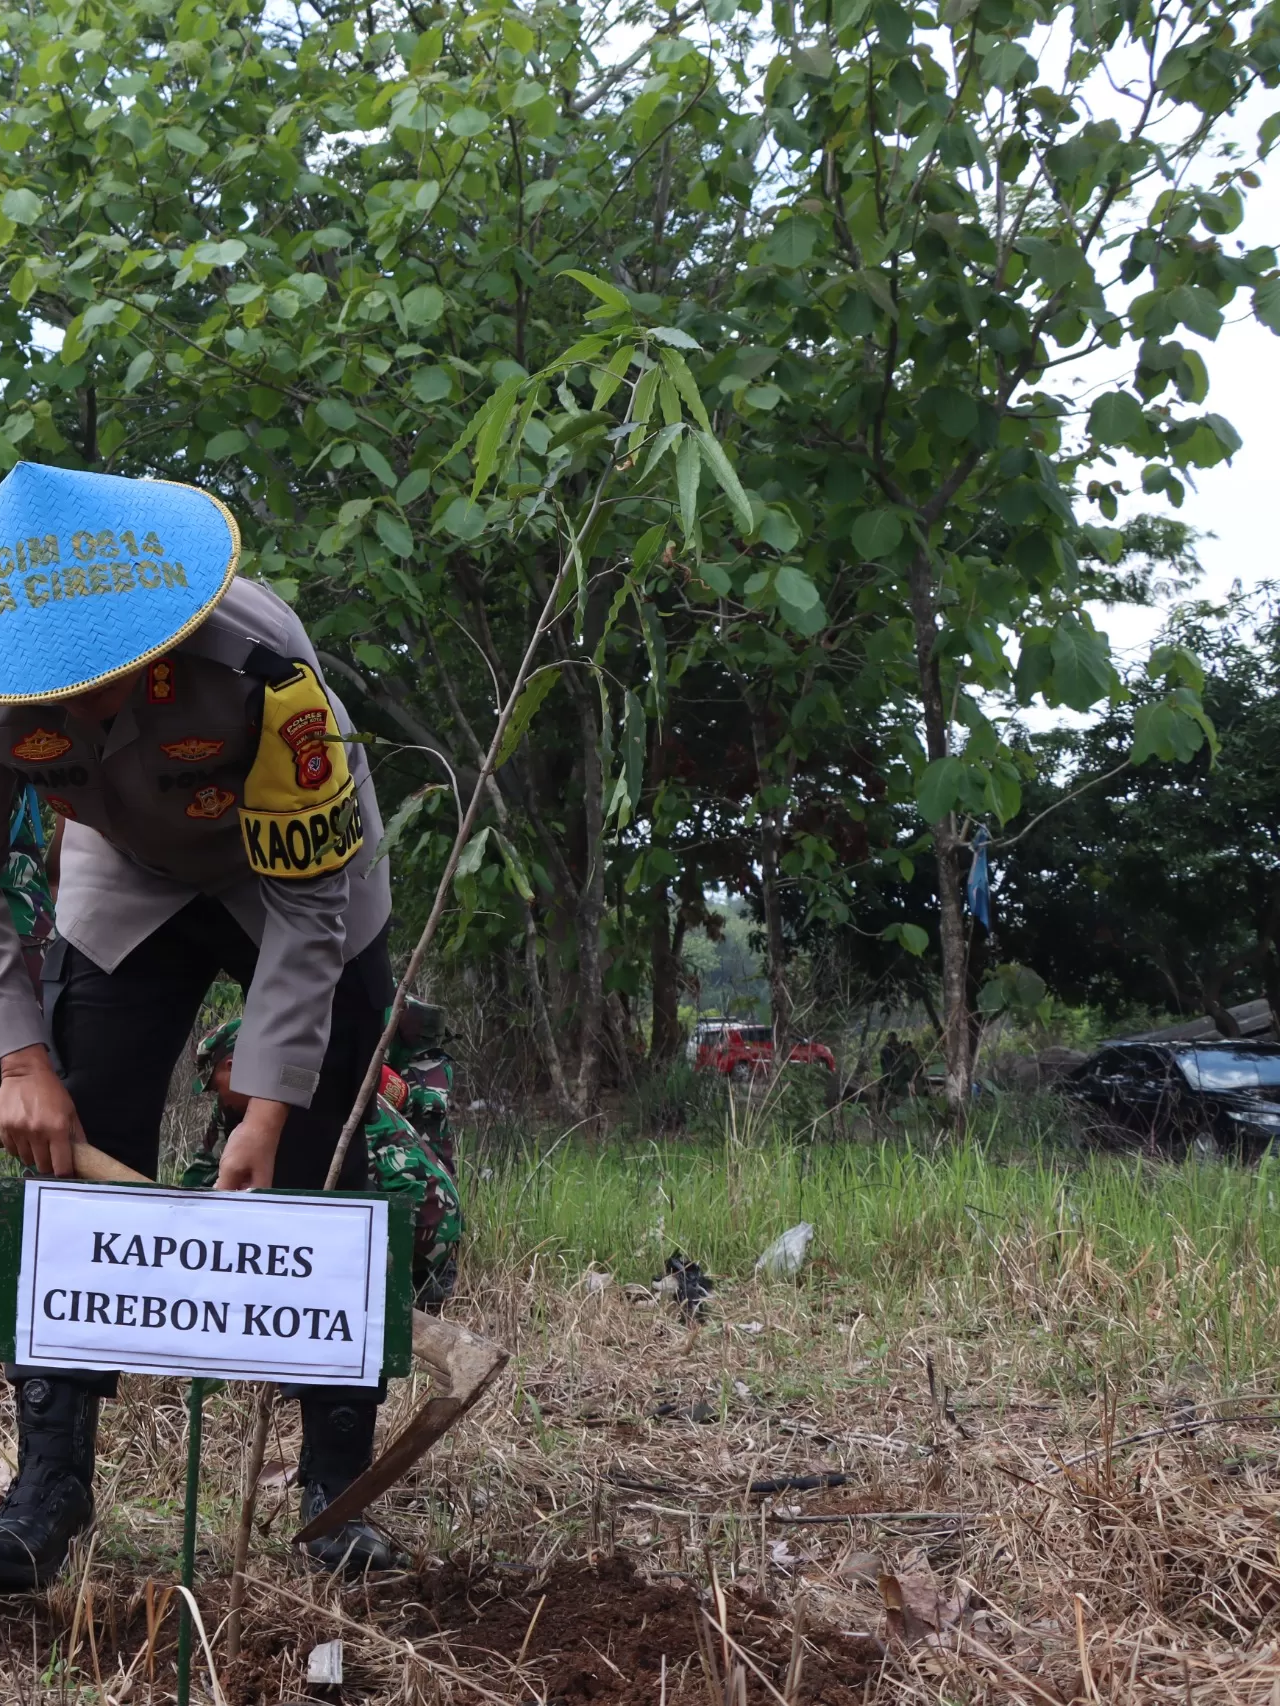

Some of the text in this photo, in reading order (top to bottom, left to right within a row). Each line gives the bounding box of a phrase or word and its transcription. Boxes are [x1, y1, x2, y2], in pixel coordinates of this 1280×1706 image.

[72, 529, 164, 561] 0614
[23, 559, 188, 608] CIREBON
[90, 1231, 315, 1279] KAPOLRES
[43, 1288, 354, 1342] CIREBON KOTA
